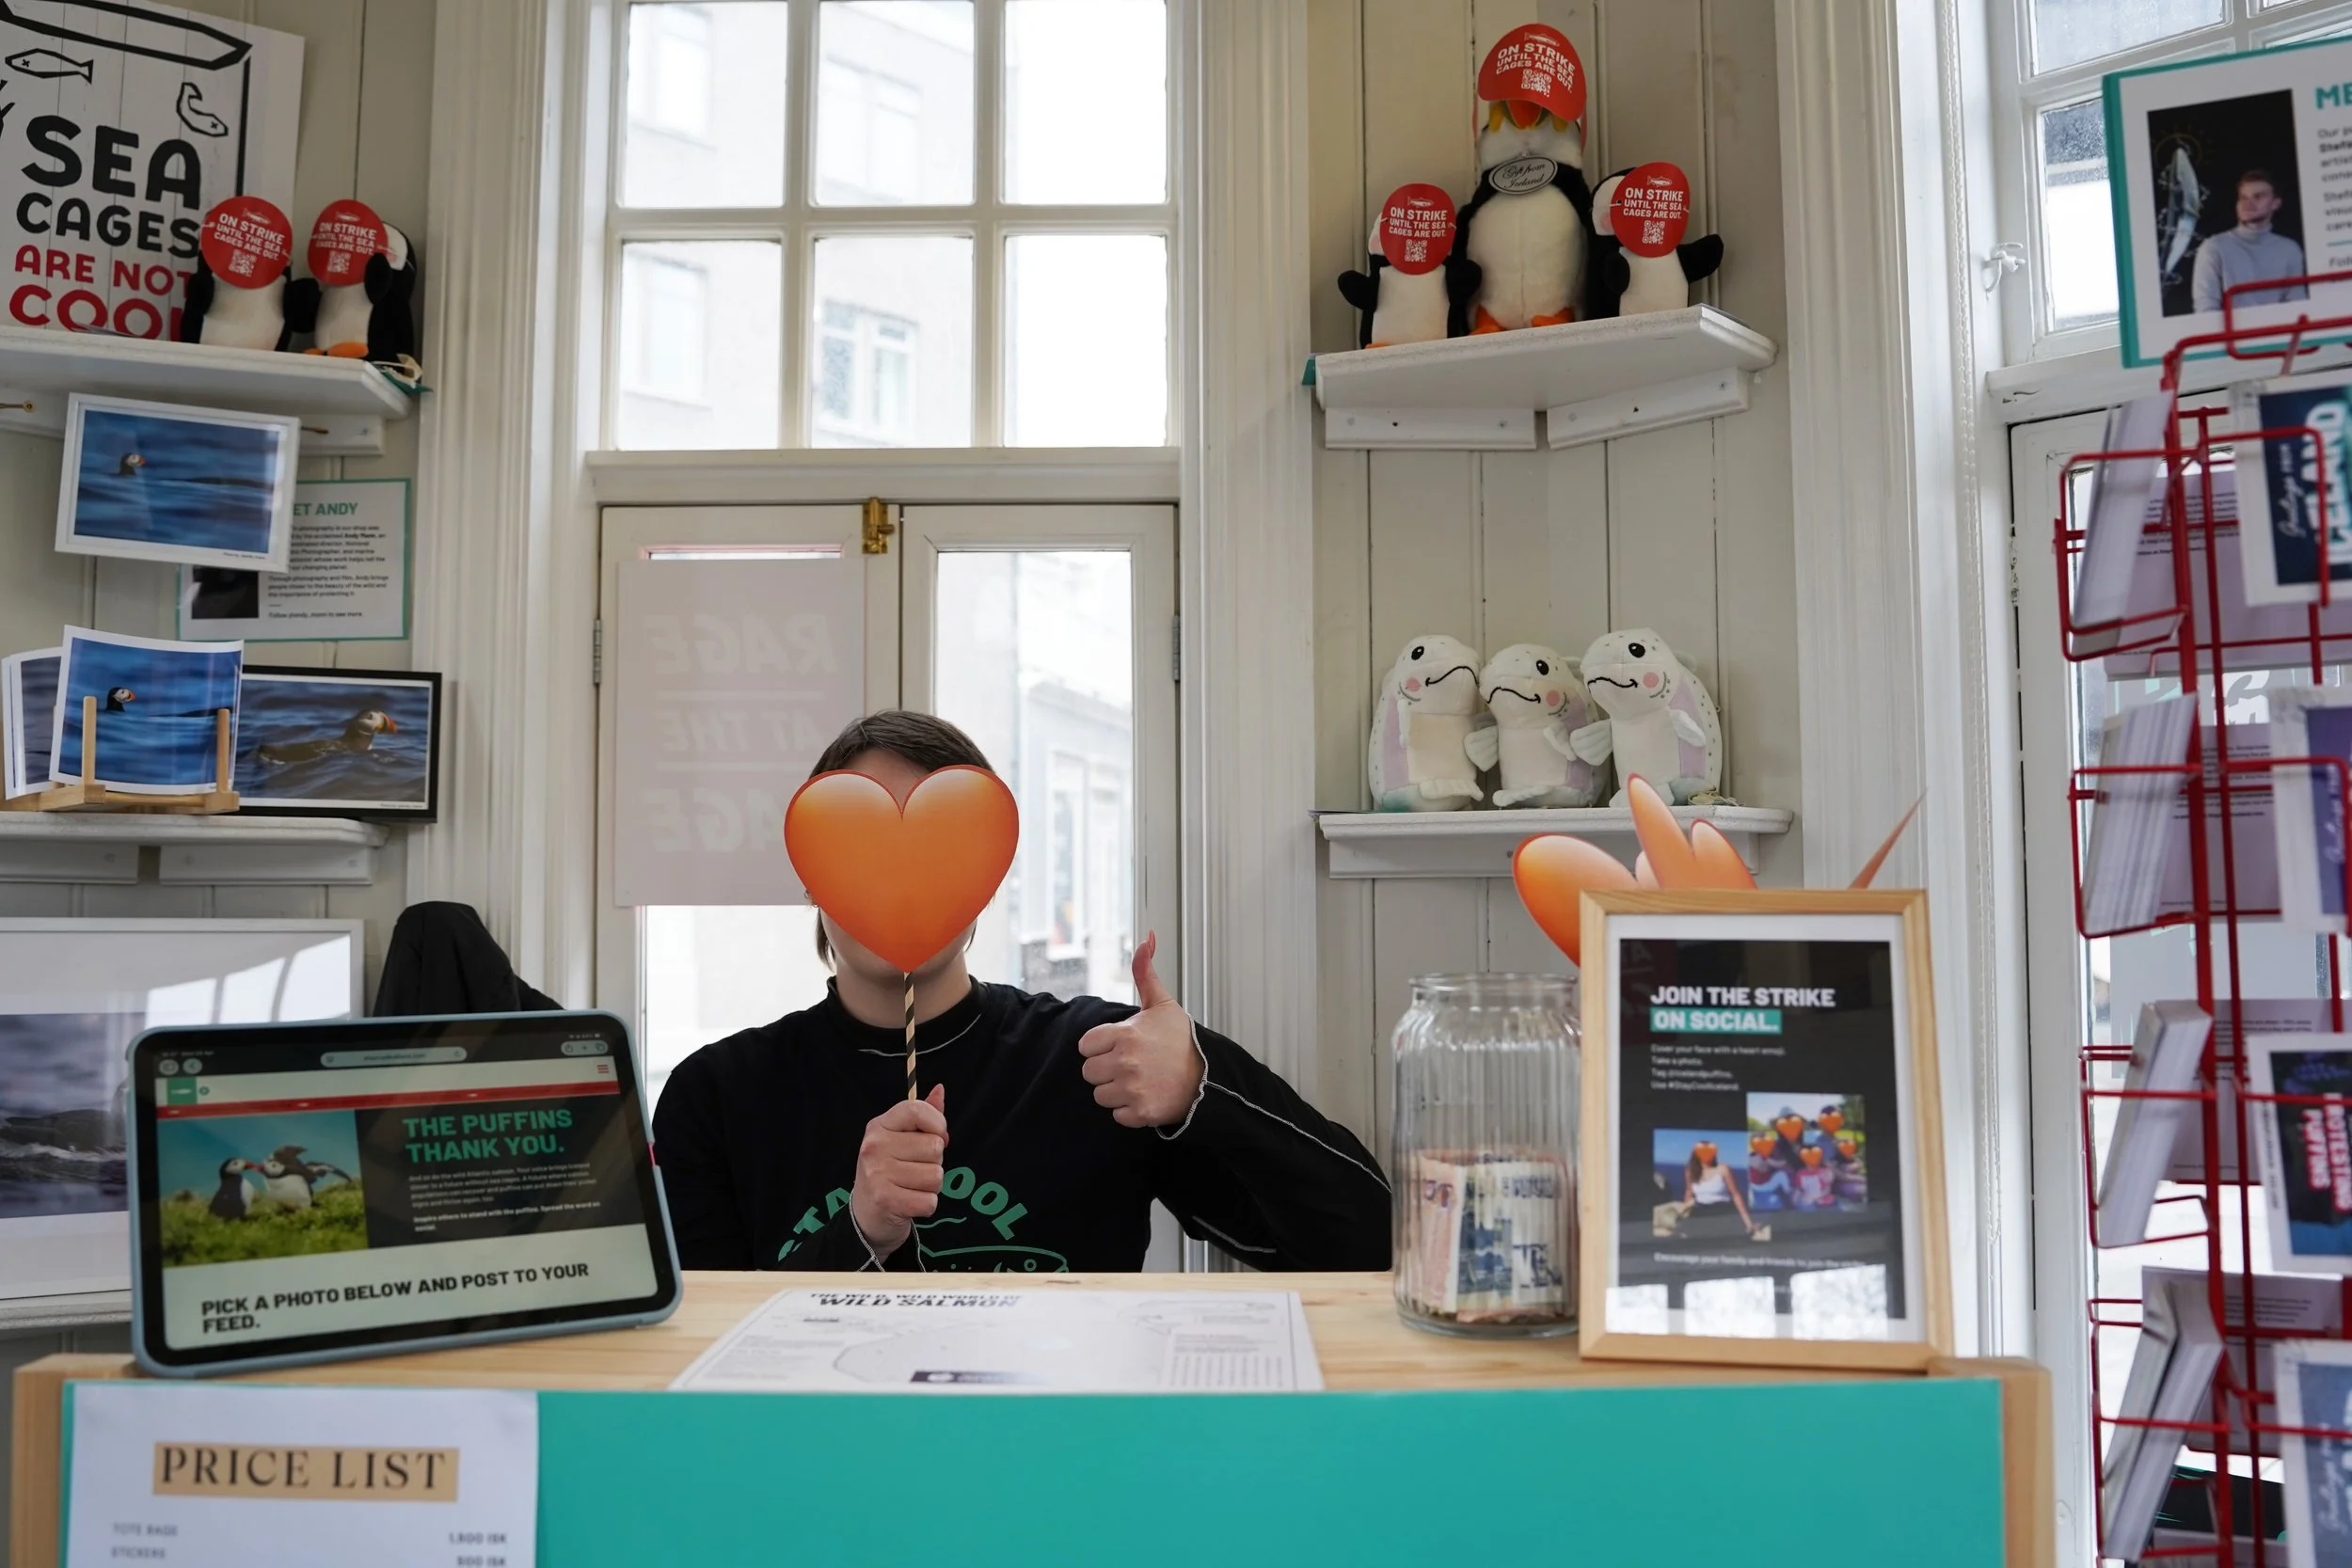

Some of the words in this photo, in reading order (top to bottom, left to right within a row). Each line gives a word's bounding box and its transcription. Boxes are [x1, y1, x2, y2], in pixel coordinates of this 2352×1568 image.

[1496, 60, 1532, 75] CAGES
[1535, 62, 1556, 75] ARE
[1497, 53, 1531, 68] UNTIL
[1534, 53, 1556, 68] THE
[1556, 64, 1573, 85] SEA
[1498, 43, 1519, 59] ON
[1524, 42, 1576, 76] STRIKE
[21, 115, 201, 211] SEA
[1626, 187, 1643, 199] ON
[1646, 189, 1684, 201] STRIKE
[1391, 207, 1404, 218] ON
[1407, 209, 1447, 221] STRIKE
[1623, 208, 1652, 217] CAGES
[1624, 199, 1651, 209] UNTIL
[1652, 201, 1669, 211] THE
[1669, 202, 1682, 211] SEA
[16, 192, 200, 259] CAGES
[218, 213, 238, 228] ON
[240, 220, 286, 245] STRIKE
[320, 222, 333, 231] ON
[333, 223, 377, 240] STRIKE
[1389, 227, 1413, 237] CAGES
[1390, 218, 1412, 229] UNTIL
[1413, 221, 1430, 230] THE
[215, 231, 243, 248] CAGES
[244, 243, 262, 255] ARE
[216, 224, 244, 239] UNTIL
[245, 233, 262, 246] THE
[264, 241, 280, 253] SEA
[339, 233, 354, 243] THE
[356, 237, 374, 247] SEA
[339, 243, 354, 252] ARE
[15, 245, 96, 284] ARE
[315, 502, 358, 515] ANDY
[1650, 986, 1703, 1006] JOIN
[1707, 987, 1750, 1006] THE
[1754, 988, 1836, 1007] STRIKE
[1654, 1010, 1686, 1029] ON
[1690, 1010, 1780, 1032] SOCIAL.
[403, 1116, 457, 1138] THE
[462, 1109, 573, 1134] PUFFINS
[405, 1136, 501, 1164] THANK
[503, 1133, 564, 1156] YOU.
[941, 1166, 1028, 1241] OOL
[201, 1296, 248, 1316] PICK
[255, 1294, 269, 1311] A
[274, 1289, 340, 1309] PHOTO
[344, 1280, 412, 1302] BELOW
[418, 1276, 457, 1294] AND
[461, 1271, 510, 1290] POST
[514, 1268, 538, 1283] TO
[541, 1263, 589, 1281] YOUR
[898, 1298, 1019, 1307] SALMON
[202, 1314, 261, 1334] FEED.
[161, 1447, 310, 1488] PRICE
[333, 1451, 446, 1490] LIST
[111, 1546, 166, 1560] STICKERS
